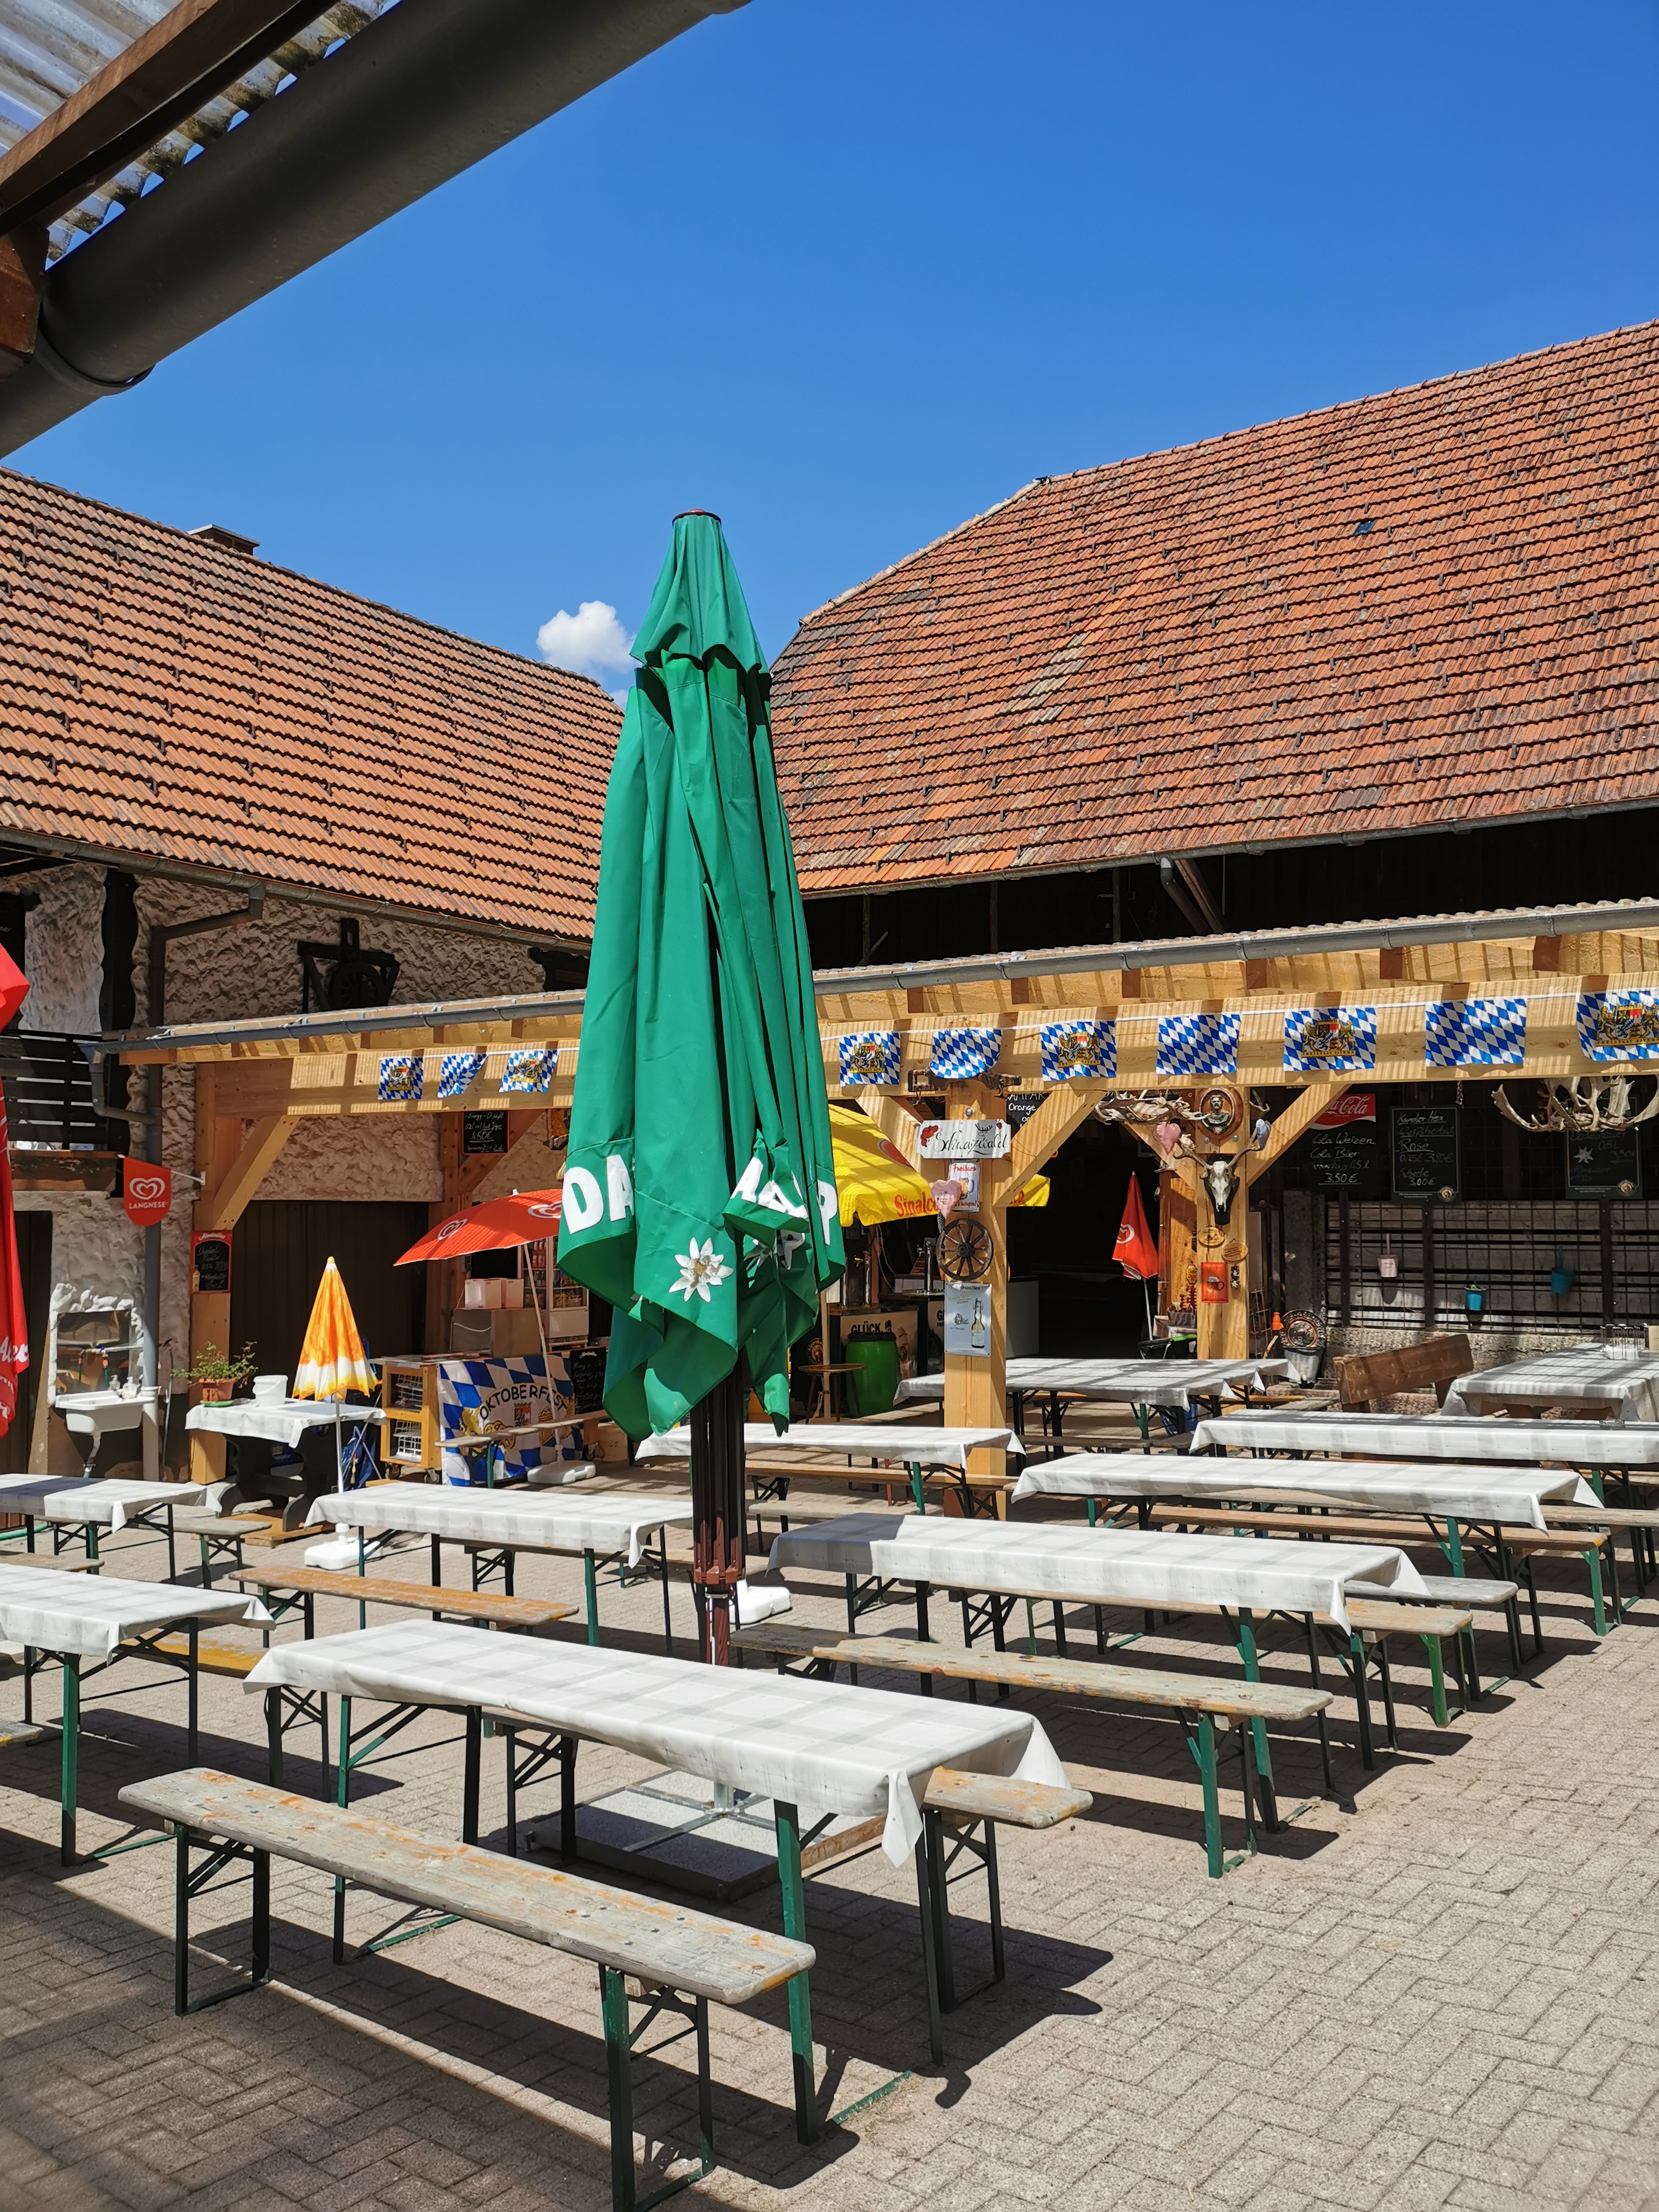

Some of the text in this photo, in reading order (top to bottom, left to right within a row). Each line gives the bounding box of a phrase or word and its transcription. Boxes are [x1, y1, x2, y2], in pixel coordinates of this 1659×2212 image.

[1009, 1103, 1036, 1115] Orange
[1336, 1132, 1376, 1145] Weizen
[480, 1385, 567, 1419] OKTOBERFEST
